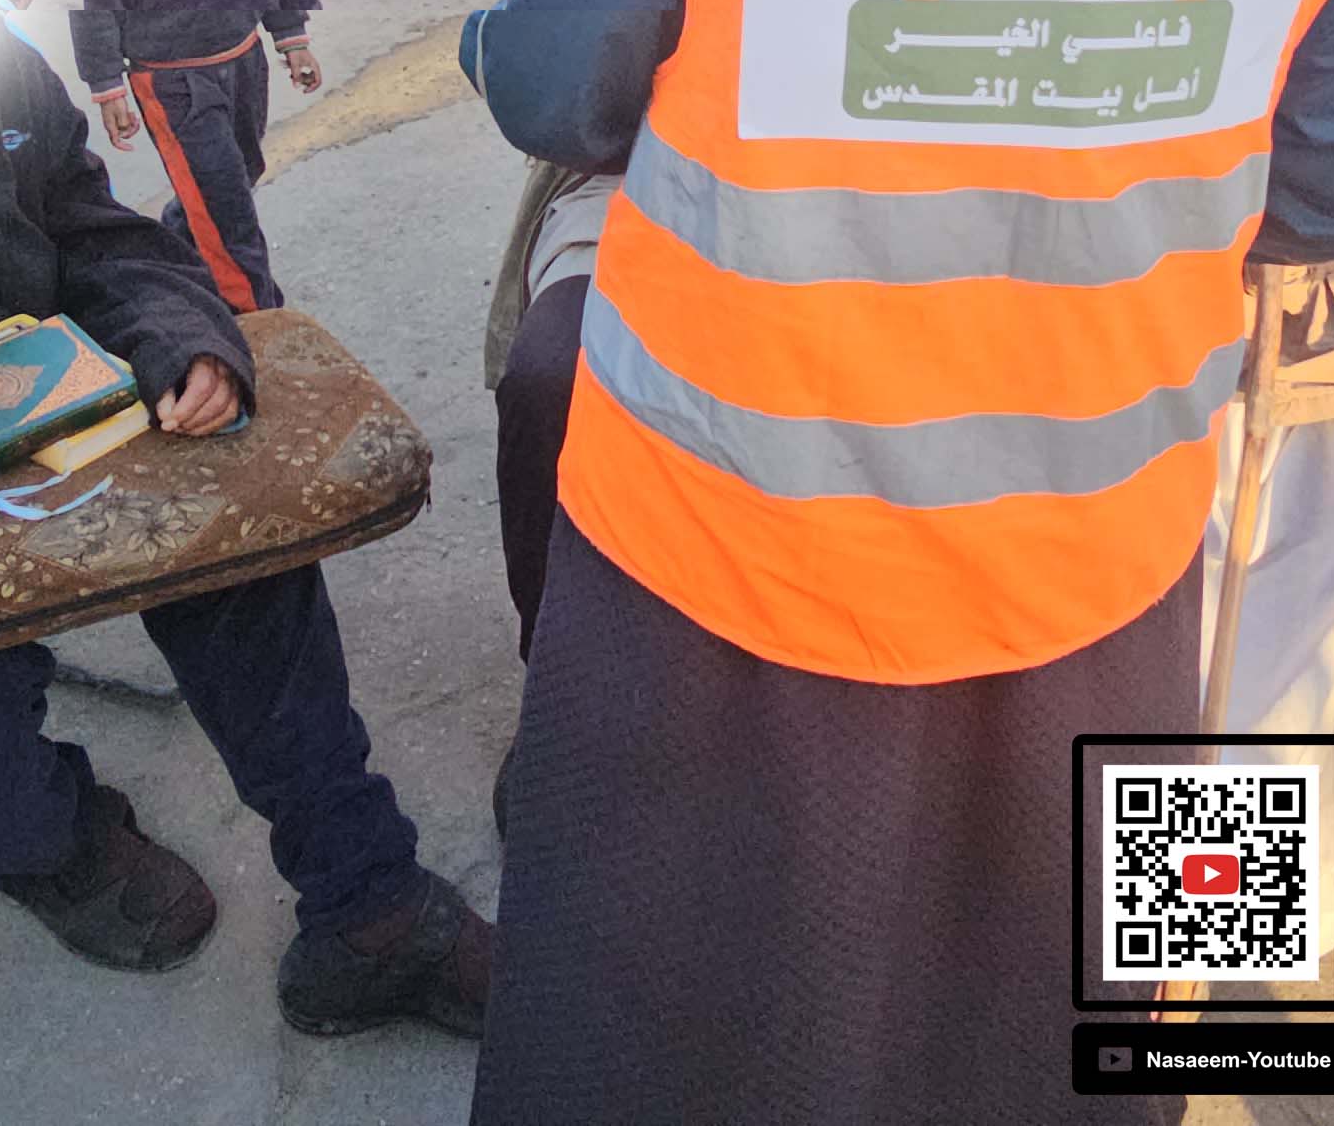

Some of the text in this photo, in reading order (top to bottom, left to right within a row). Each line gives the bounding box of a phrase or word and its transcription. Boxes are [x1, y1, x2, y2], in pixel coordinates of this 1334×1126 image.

[884, 14, 1192, 64] فاعلي الخير
[861, 67, 1202, 117] أهل بيت المقدس
